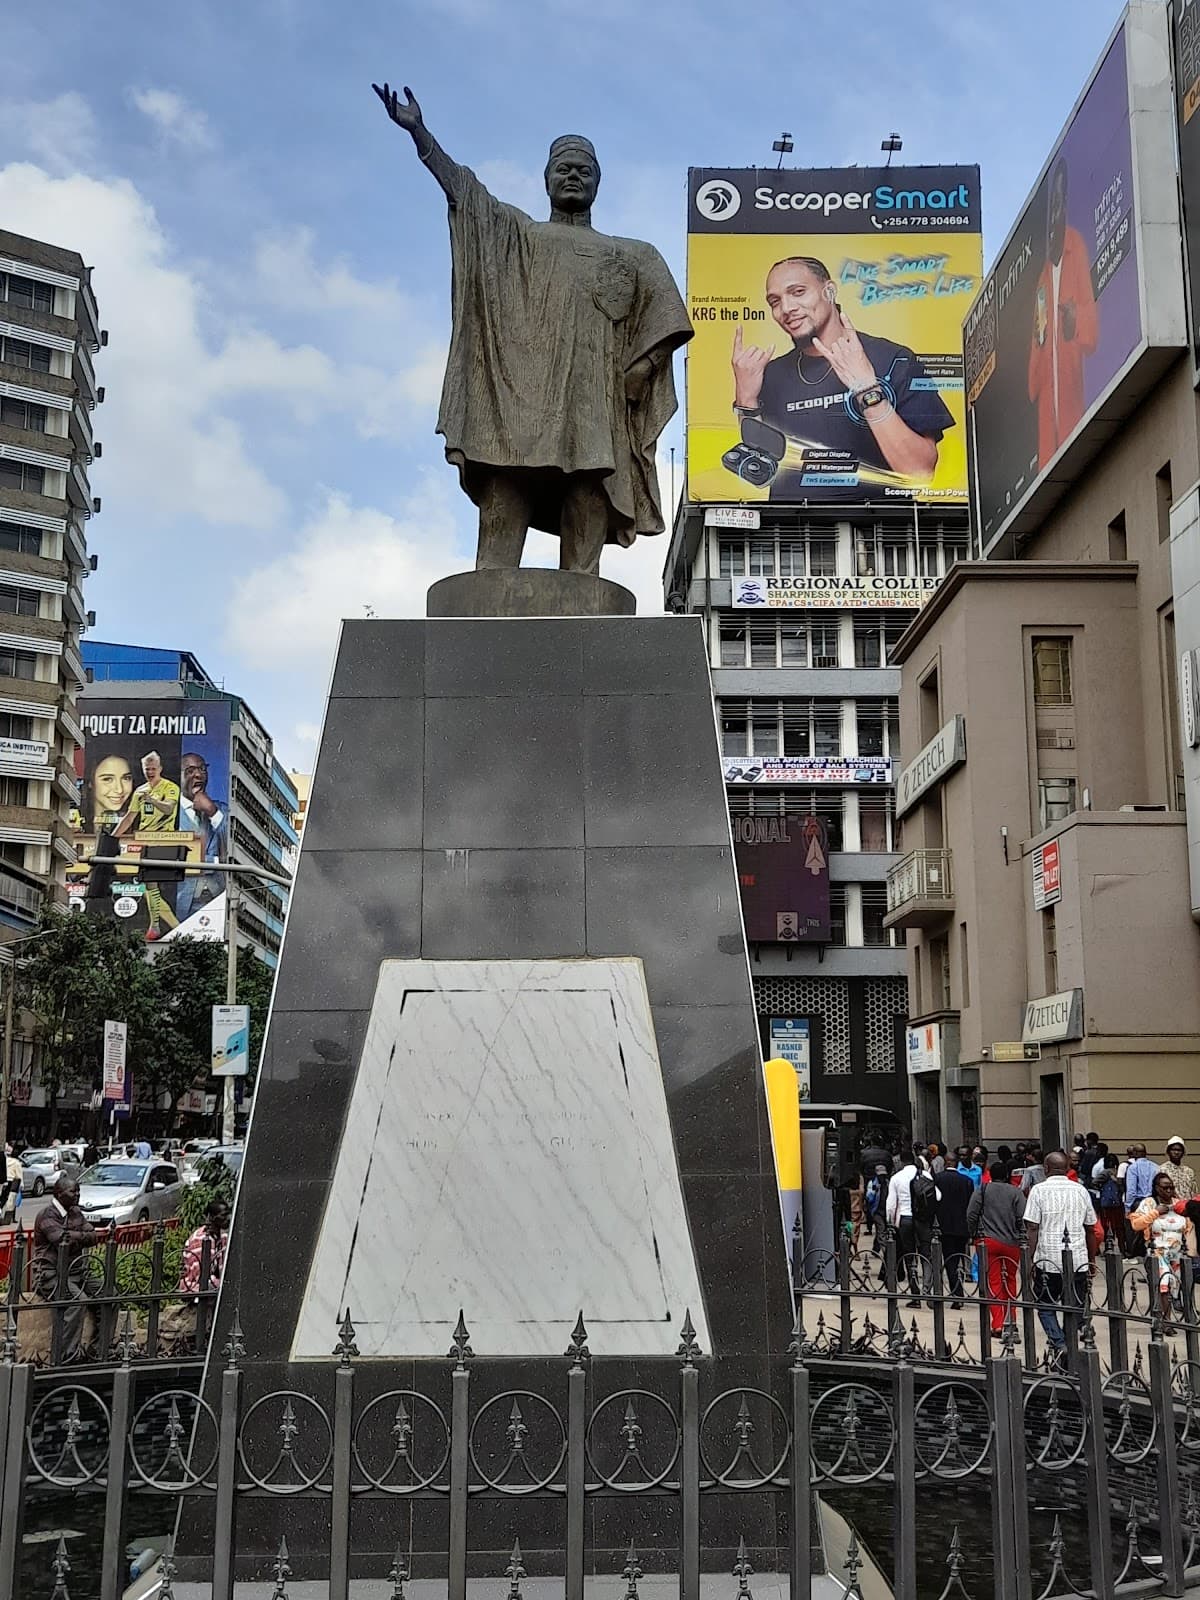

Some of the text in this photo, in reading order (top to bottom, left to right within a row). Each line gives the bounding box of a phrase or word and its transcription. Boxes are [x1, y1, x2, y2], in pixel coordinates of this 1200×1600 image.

[875, 184, 969, 209] Smart
[1094, 170, 1122, 224] Infinix
[883, 216, 969, 226] +254 778 304694
[1097, 218, 1129, 274] KSH 9,499
[1000, 235, 1033, 310] Infinix
[692, 306, 765, 321] KRG the Don
[808, 451, 851, 459] Digital Display
[884, 487, 920, 497] Scooper
[921, 487, 945, 496] News
[715, 508, 737, 518] LIVE
[766, 577, 866, 590] REGIONAL
[767, 590, 831, 599] SHARPNESS
[833, 590, 849, 599] OF
[852, 590, 920, 599] EXCELLENCE
[128, 716, 146, 735] ZA
[150, 716, 207, 735] FAMILIA
[12, 742, 46, 753] INSTITUTE
[912, 737, 946, 793] ZETECH
[730, 816, 792, 843] IONAL
[1036, 1001, 1069, 1028] ZETECH
